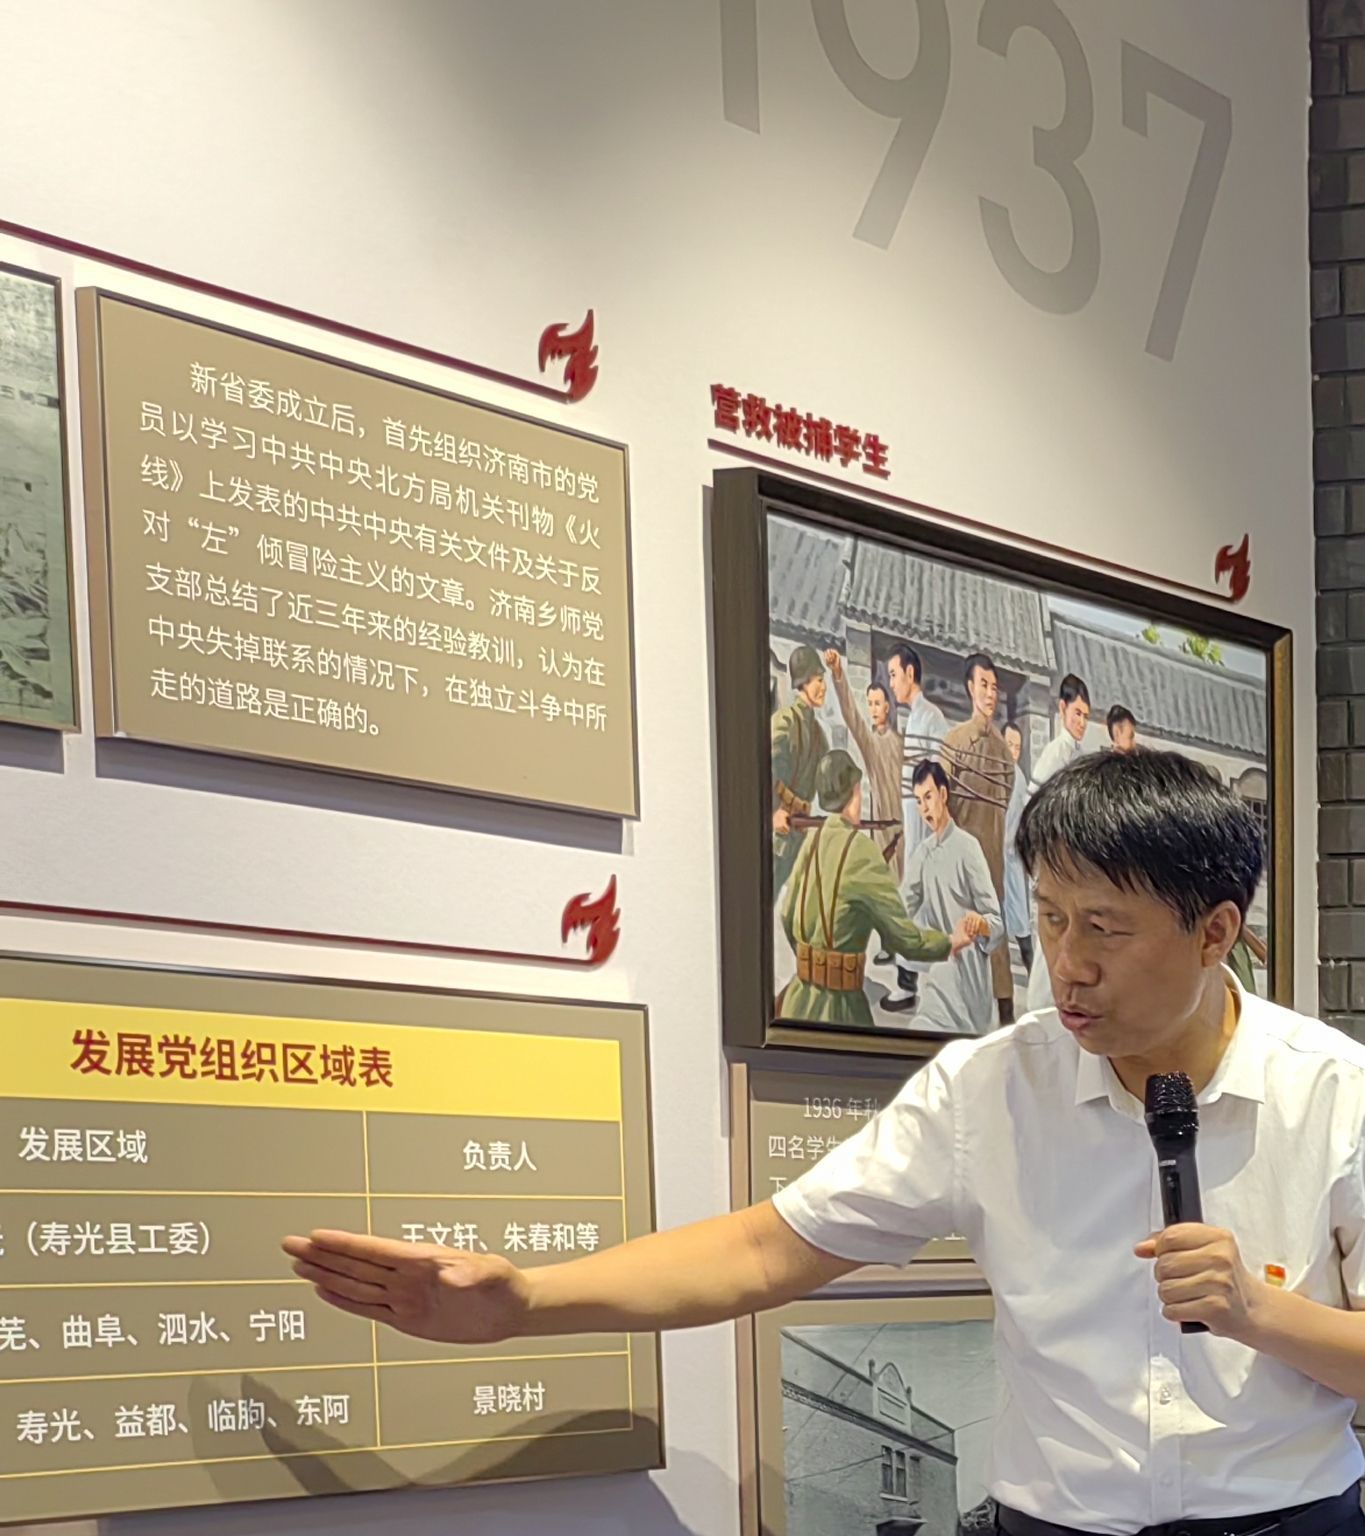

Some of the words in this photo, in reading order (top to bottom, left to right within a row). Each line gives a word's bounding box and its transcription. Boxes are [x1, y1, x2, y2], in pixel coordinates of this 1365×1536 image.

[190, 361, 599, 503] 新省委成立后，首先组织济南市的党
[710, 383, 891, 480] 营救被捕学生
[139, 400, 600, 550] 员以学习中共中央北方局机关刊物《火
[141, 453, 602, 596] 线》上发表的中共中央有关文件及关于反
[143, 508, 604, 641] 对“左”倾冒险主义的文章。济南乡师党
[146, 561, 606, 687] 支部总结了近三年来的经验教训，认为在
[148, 615, 607, 731] 中央失掉联系的情况下，在独立斗争中所
[150, 667, 380, 737] 走的道路是正确的。
[70, 1028, 394, 1089] 发展党组织区域表
[18, 1126, 148, 1165] 发展区域
[462, 1139, 537, 1173] 负责人
[0, 1221, 213, 1257] （寿光县工委）
[401, 1222, 599, 1252] 王文轩、朱春和等
[0, 1310, 306, 1351] 芜、曲阜、泗水、宁阳
[17, 1393, 350, 1445] 寿光、益都、临朐、东阿
[472, 1382, 546, 1415] 景晓村
